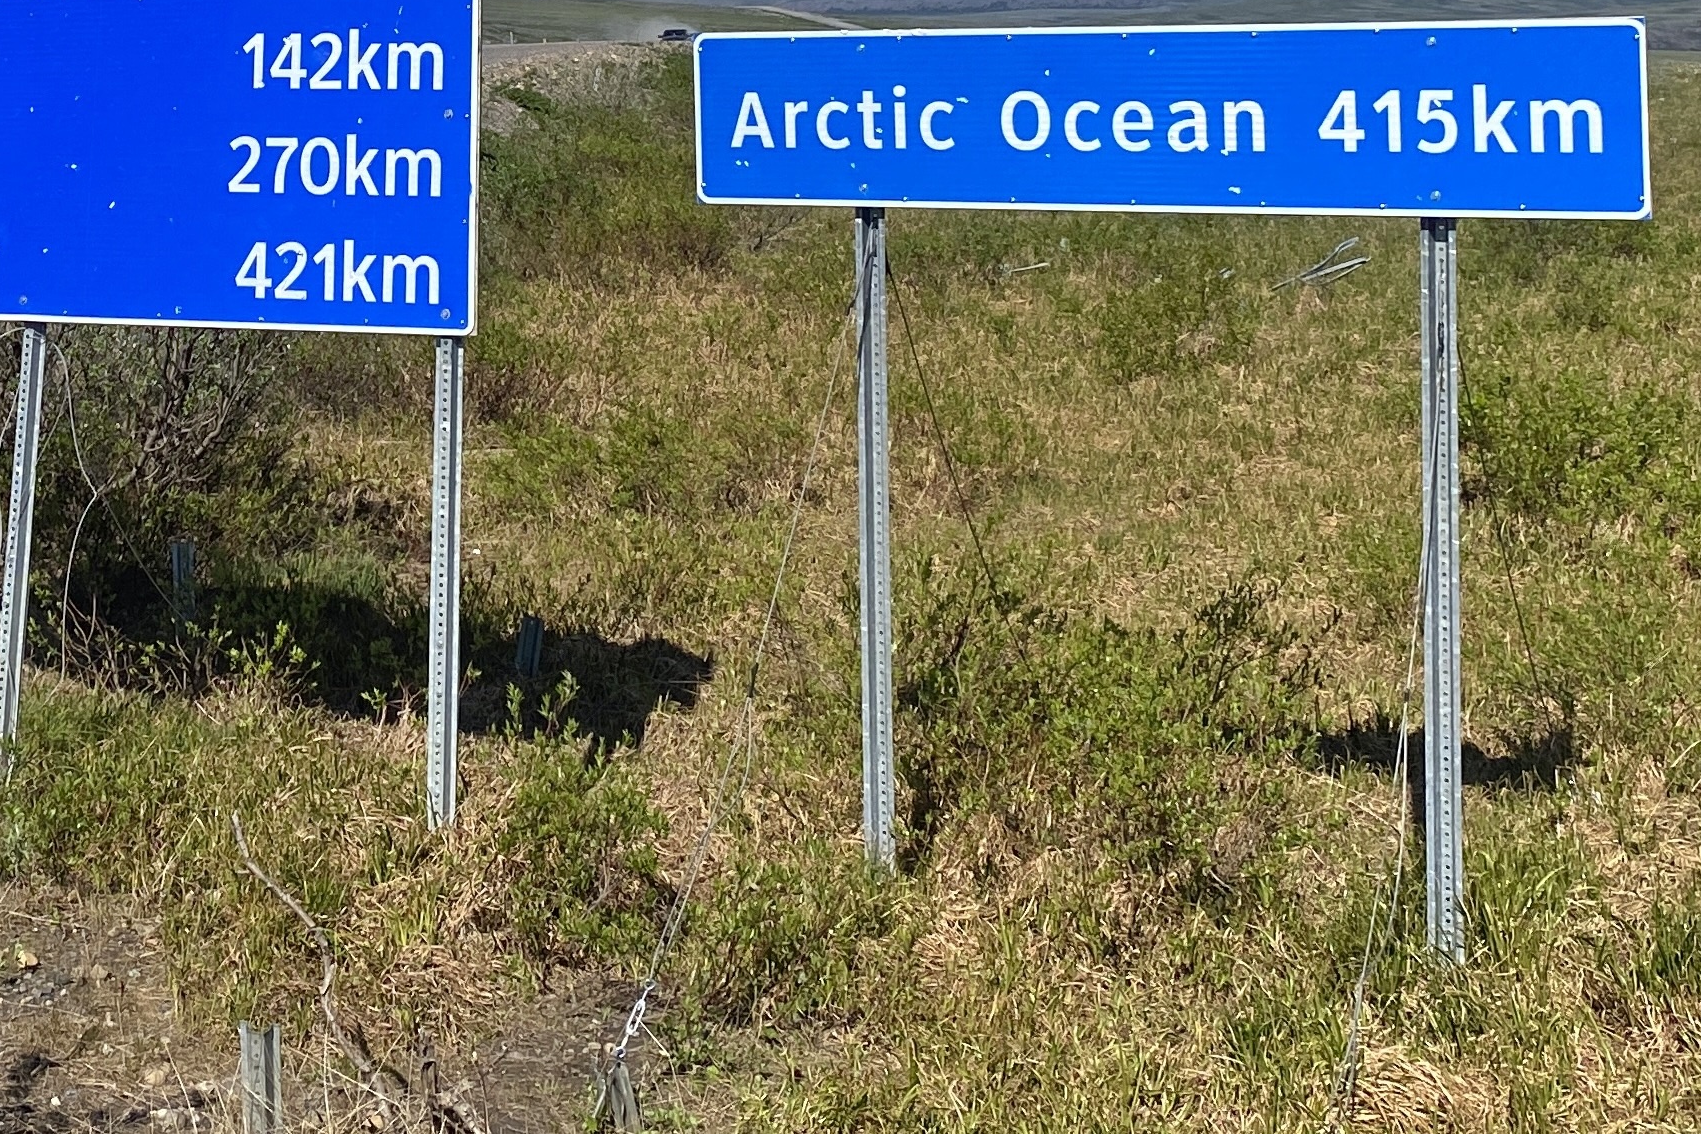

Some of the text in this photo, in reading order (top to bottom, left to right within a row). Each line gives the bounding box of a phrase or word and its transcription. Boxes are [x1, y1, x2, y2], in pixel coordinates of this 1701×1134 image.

[243, 29, 443, 90] 142km
[732, 85, 1602, 154] Arctic Ocean 415km
[229, 134, 441, 196] 270km
[235, 240, 439, 304] 421km
